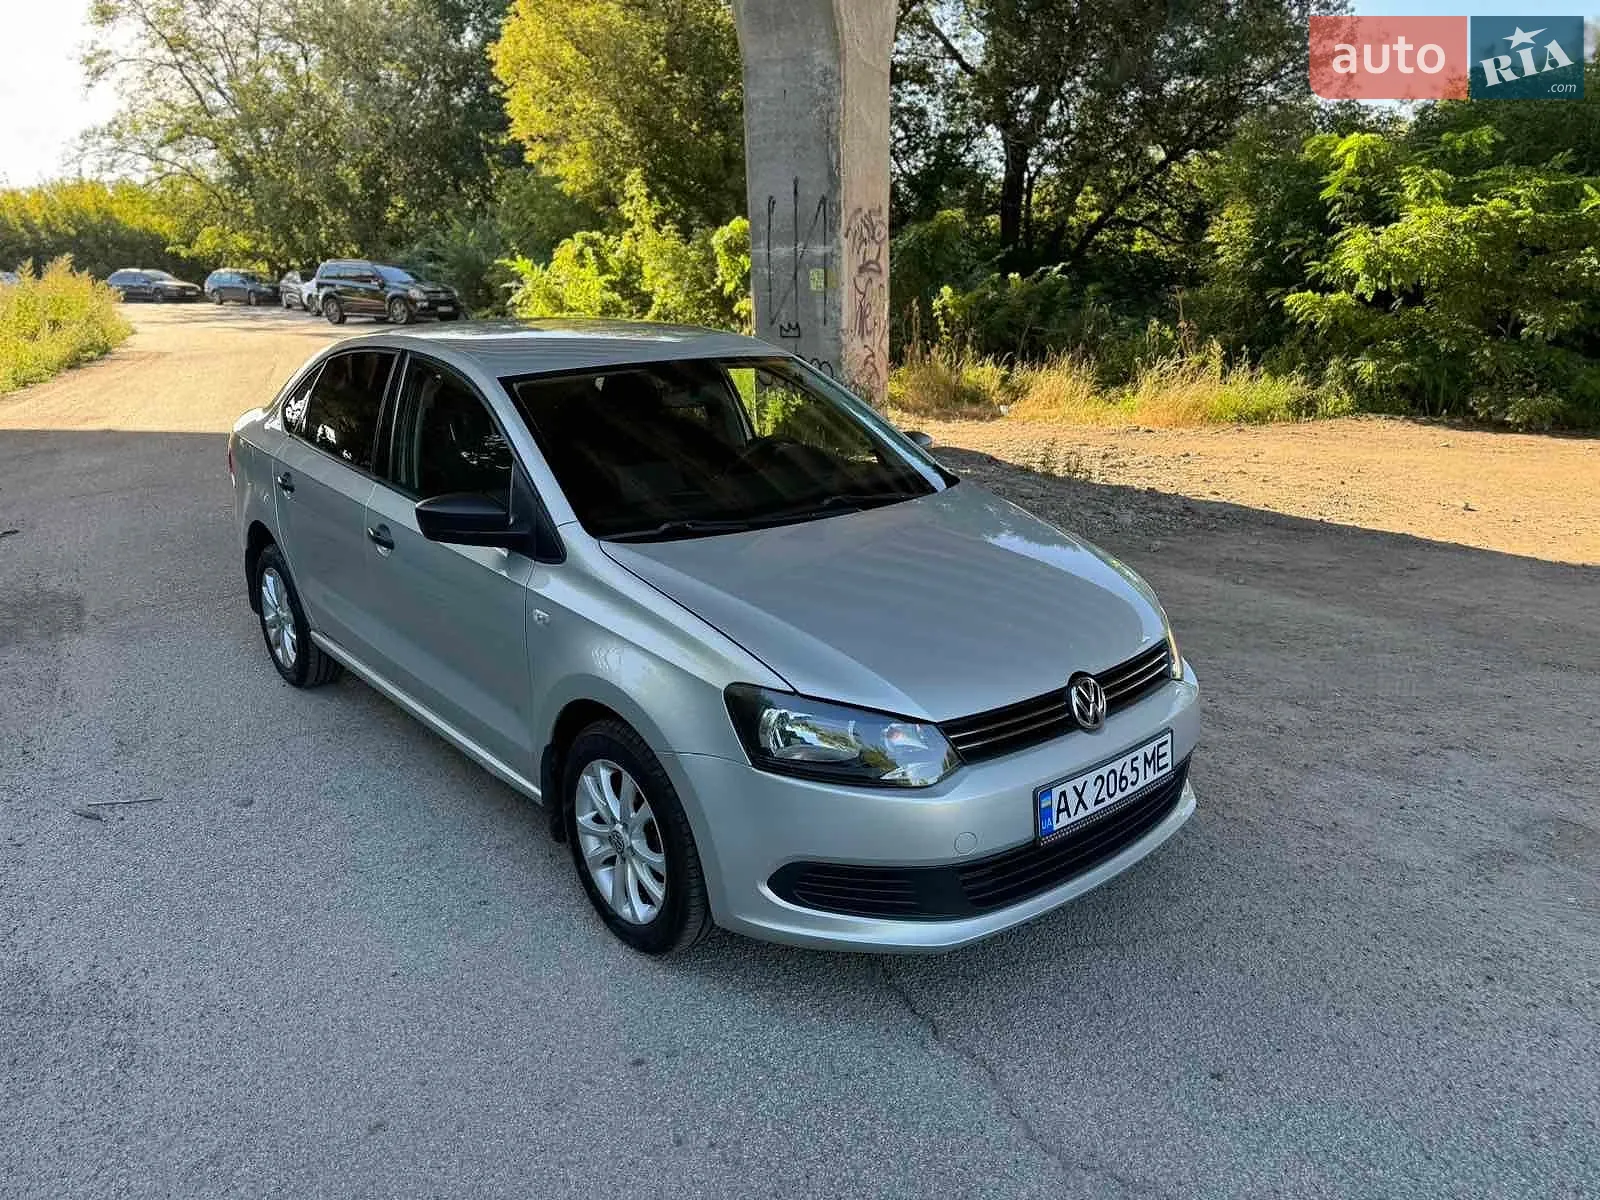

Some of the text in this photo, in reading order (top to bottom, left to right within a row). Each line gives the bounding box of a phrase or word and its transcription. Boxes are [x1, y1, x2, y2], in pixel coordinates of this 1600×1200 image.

[1055, 740, 1169, 825] AX 2065 ME
[1041, 817, 1053, 830] UA
